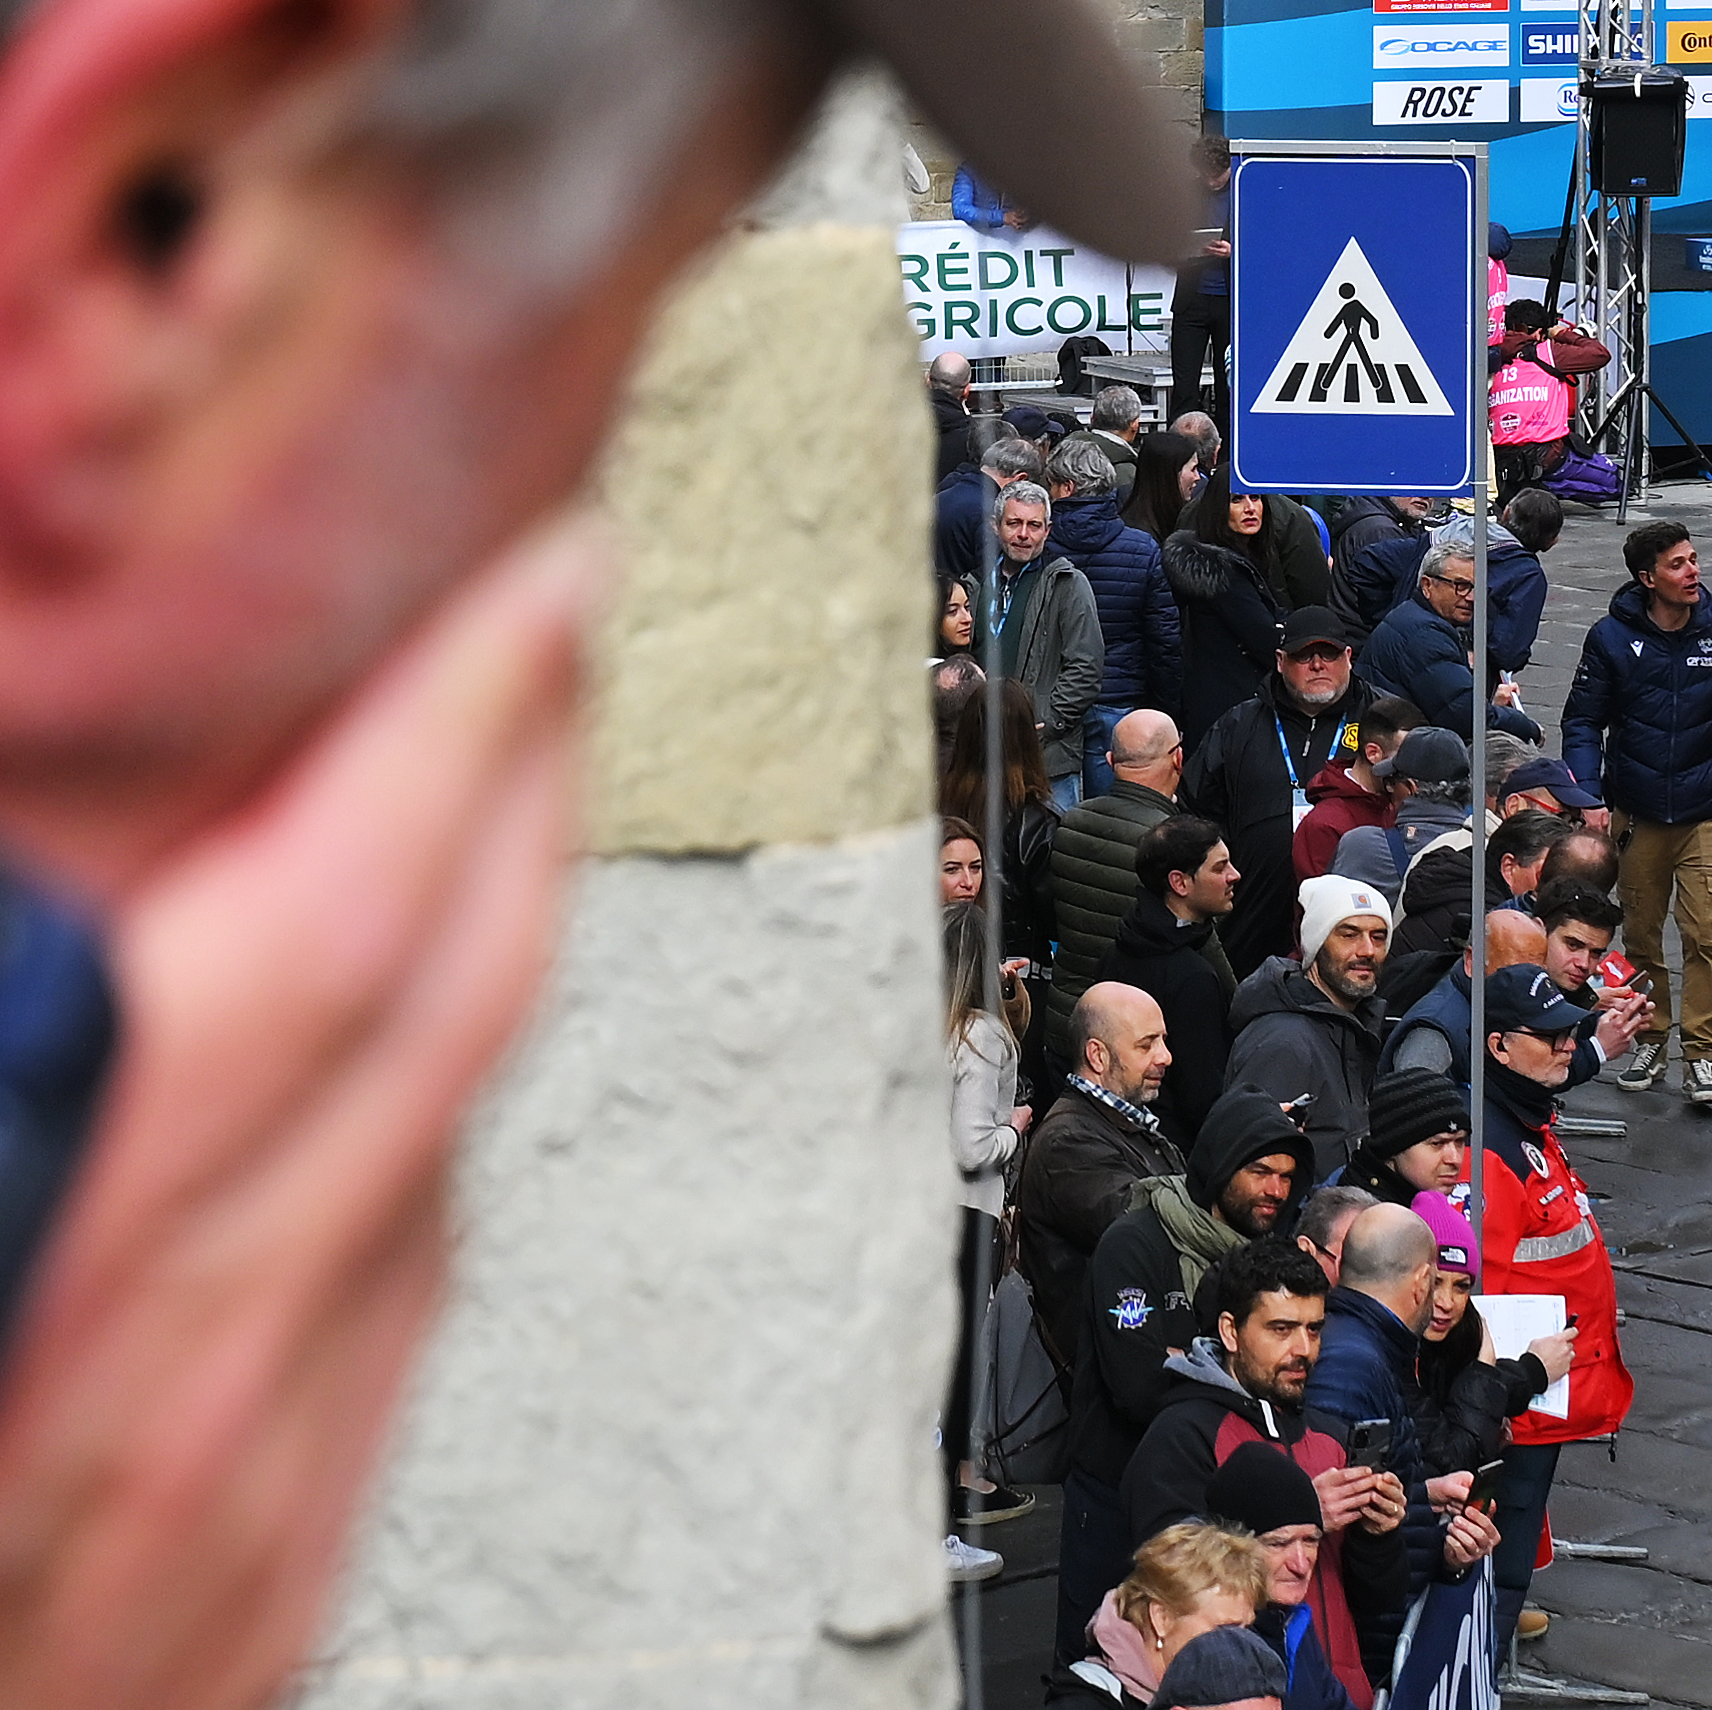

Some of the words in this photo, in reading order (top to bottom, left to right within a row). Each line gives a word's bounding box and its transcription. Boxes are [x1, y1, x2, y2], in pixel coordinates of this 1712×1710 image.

[1401, 86, 1483, 118] ROSE
[898, 241, 1076, 293] RÉDIT
[906, 292, 1164, 342] GRICOLE
[1501, 366, 1518, 383] 13
[1488, 386, 1549, 408] GANIZATION
